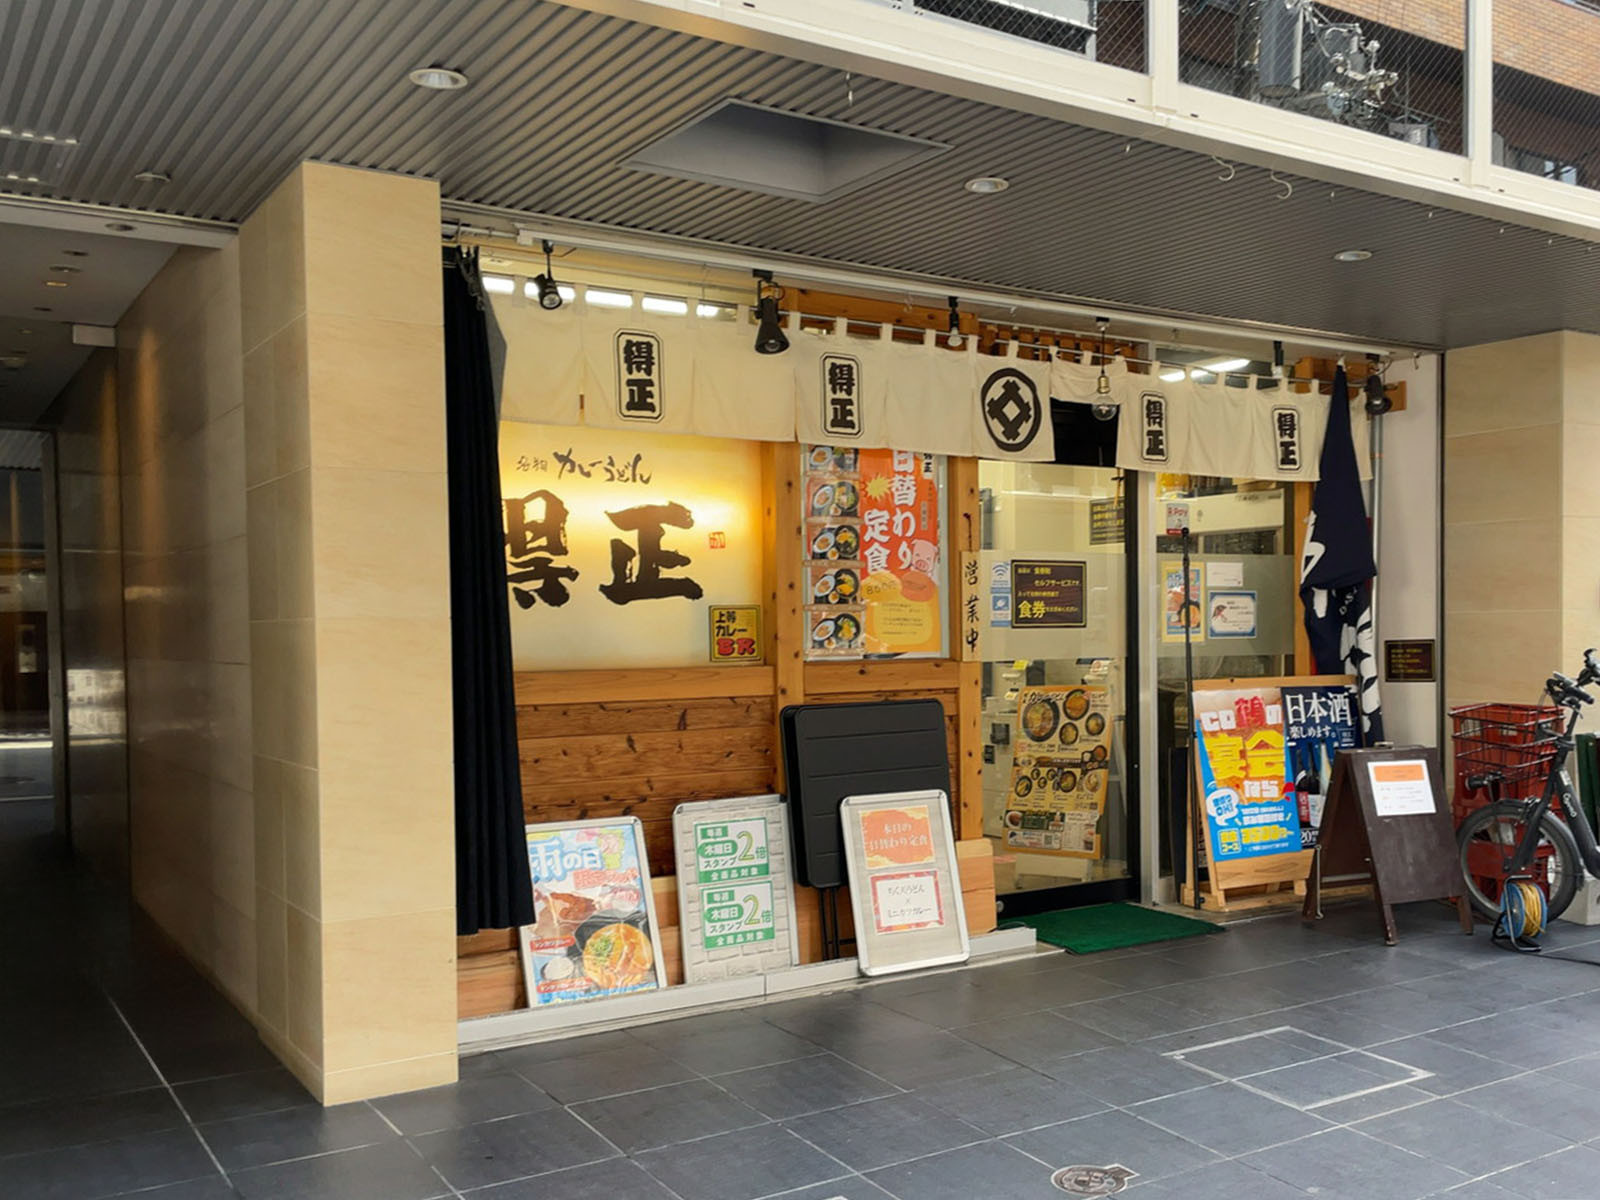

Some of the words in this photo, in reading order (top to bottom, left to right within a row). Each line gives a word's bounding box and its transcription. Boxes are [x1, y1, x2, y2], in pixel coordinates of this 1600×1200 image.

[623, 339, 657, 413] 得正
[828, 362, 856, 430] 得正
[1145, 399, 1165, 456] 得正
[863, 508, 891, 576] 定食
[715, 625, 748, 637] カレー
[1285, 692, 1352, 727] 日本酒
[704, 856, 737, 868] スタンプ
[710, 921, 743, 933] スタンプ
